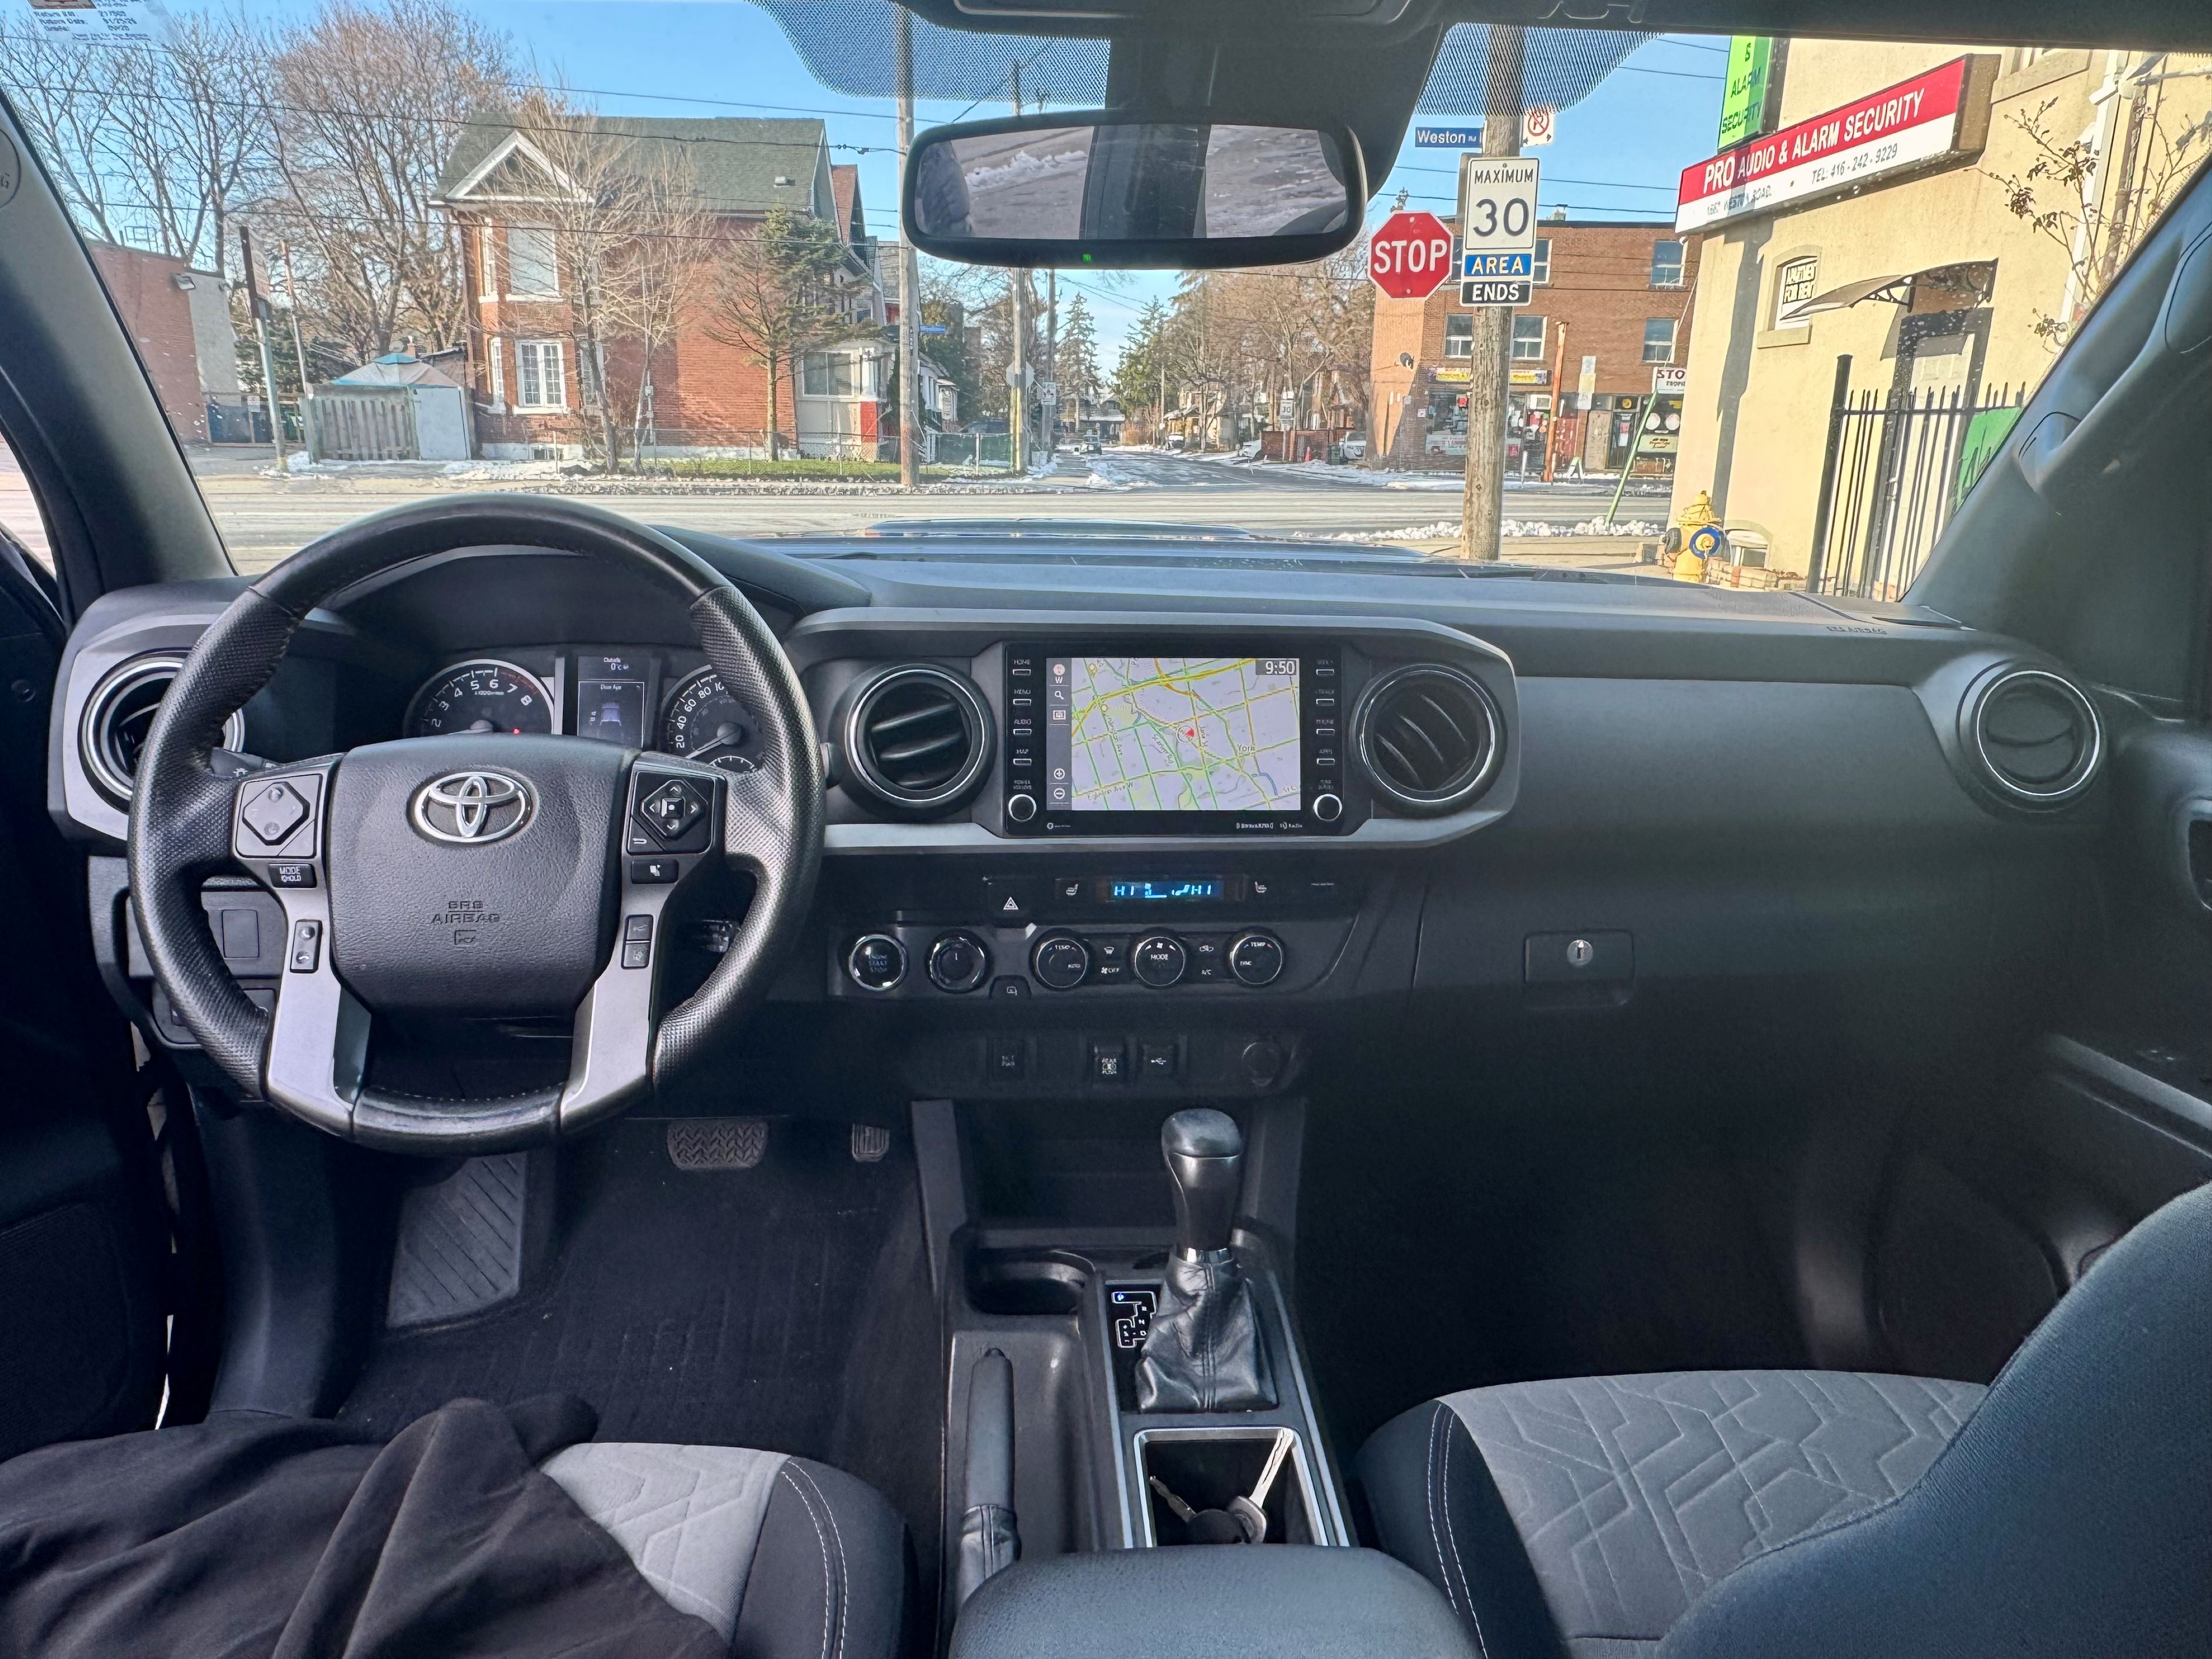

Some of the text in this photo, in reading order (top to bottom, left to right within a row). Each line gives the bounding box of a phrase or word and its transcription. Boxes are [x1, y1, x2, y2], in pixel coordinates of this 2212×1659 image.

[1731, 66, 1761, 98] ALARM
[1722, 101, 1762, 134] SECURITY
[1417, 130, 1466, 144] Weston
[1703, 88, 1925, 194] PRO AUDIO & ALARM SECURITY
[1474, 169, 1533, 184] MAXIMUM
[1473, 198, 1529, 237] 30
[1373, 239, 1448, 274] STOP
[1471, 257, 1523, 275] AREA
[1472, 284, 1519, 301] ENDS
[1657, 370, 1685, 379] STO
[1265, 660, 1295, 675] 9:50
[470, 680, 480, 690] 5
[490, 679, 499, 689] 6
[507, 683, 518, 693] 7
[454, 688, 463, 697] 4
[698, 686, 711, 699] 80
[439, 701, 449, 711] 3
[520, 695, 532, 706] 8
[684, 699, 697, 712] 60
[431, 719, 441, 728] 2
[676, 716, 687, 730] 40
[675, 735, 685, 749] 20
[279, 866, 300, 875] MODE
